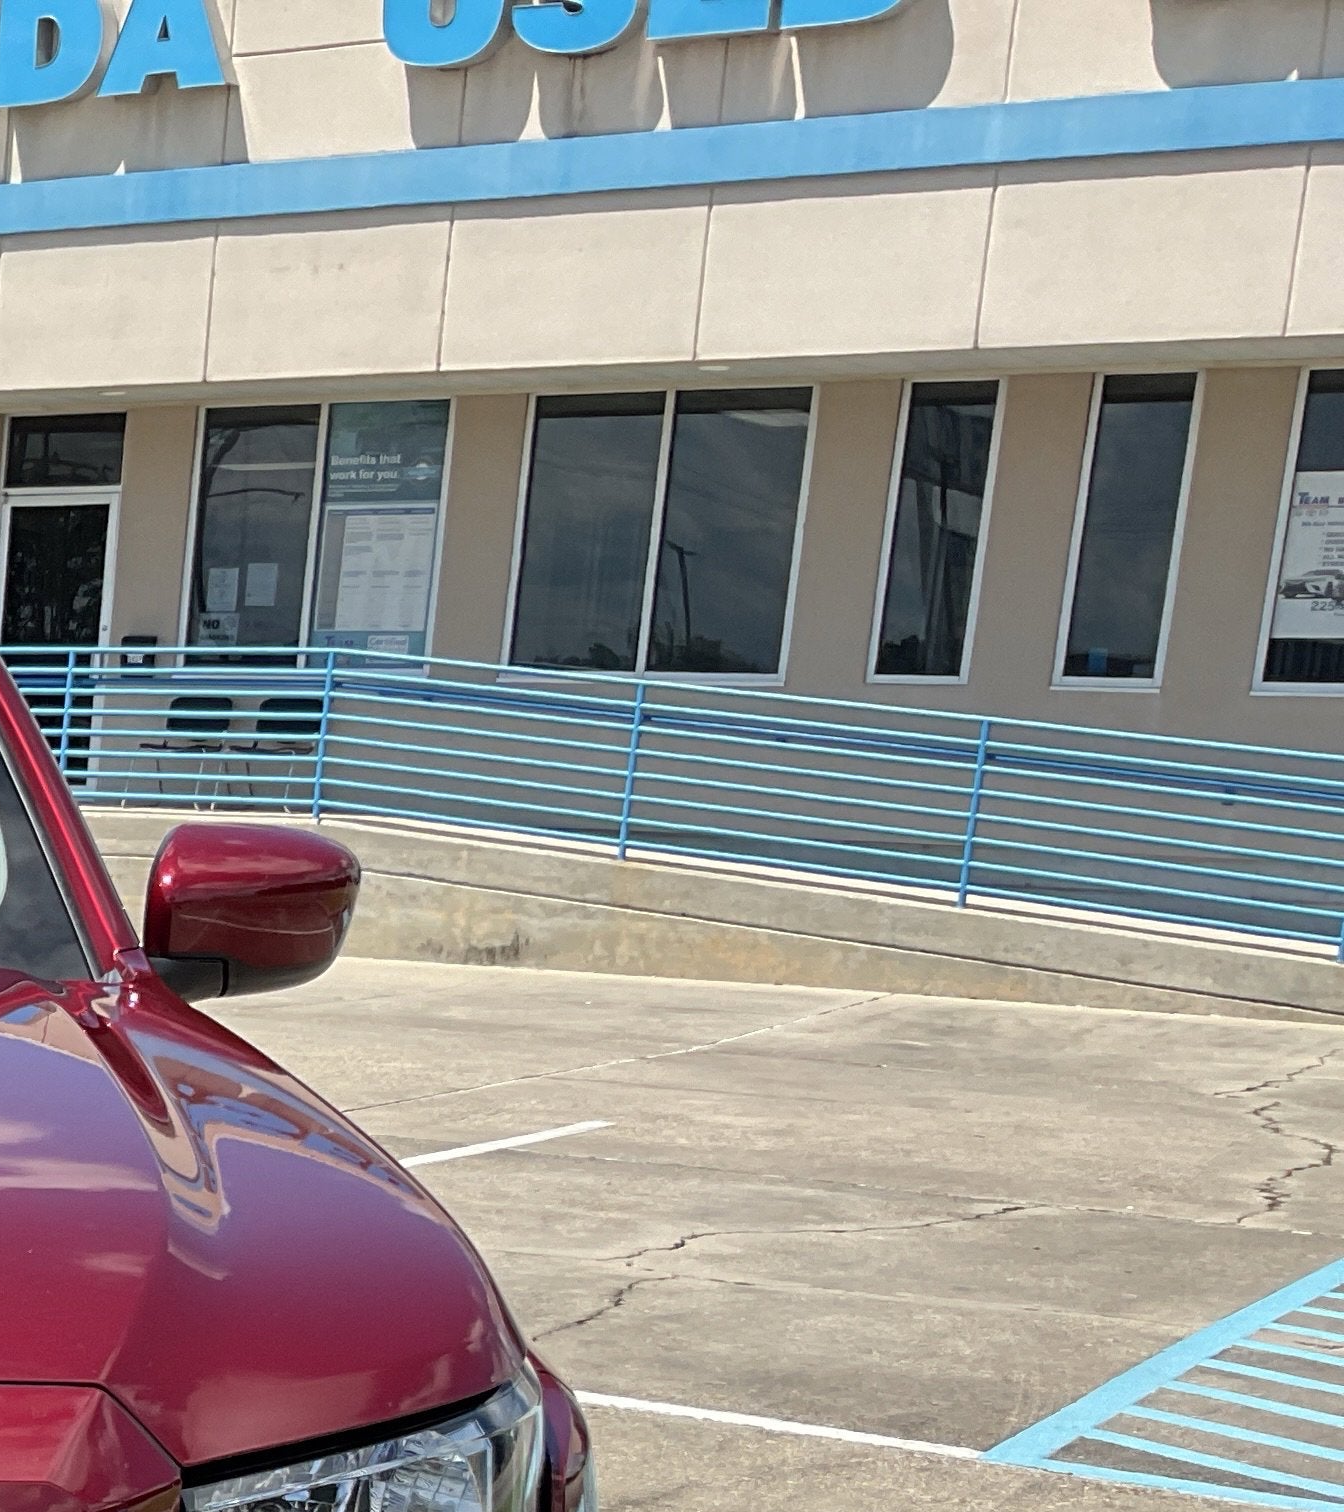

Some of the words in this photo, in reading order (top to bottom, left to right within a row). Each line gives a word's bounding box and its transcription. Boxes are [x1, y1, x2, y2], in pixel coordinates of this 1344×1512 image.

[331, 454, 376, 466] Benefits
[379, 453, 401, 465] that
[330, 471, 357, 480] work
[359, 469, 375, 479] for
